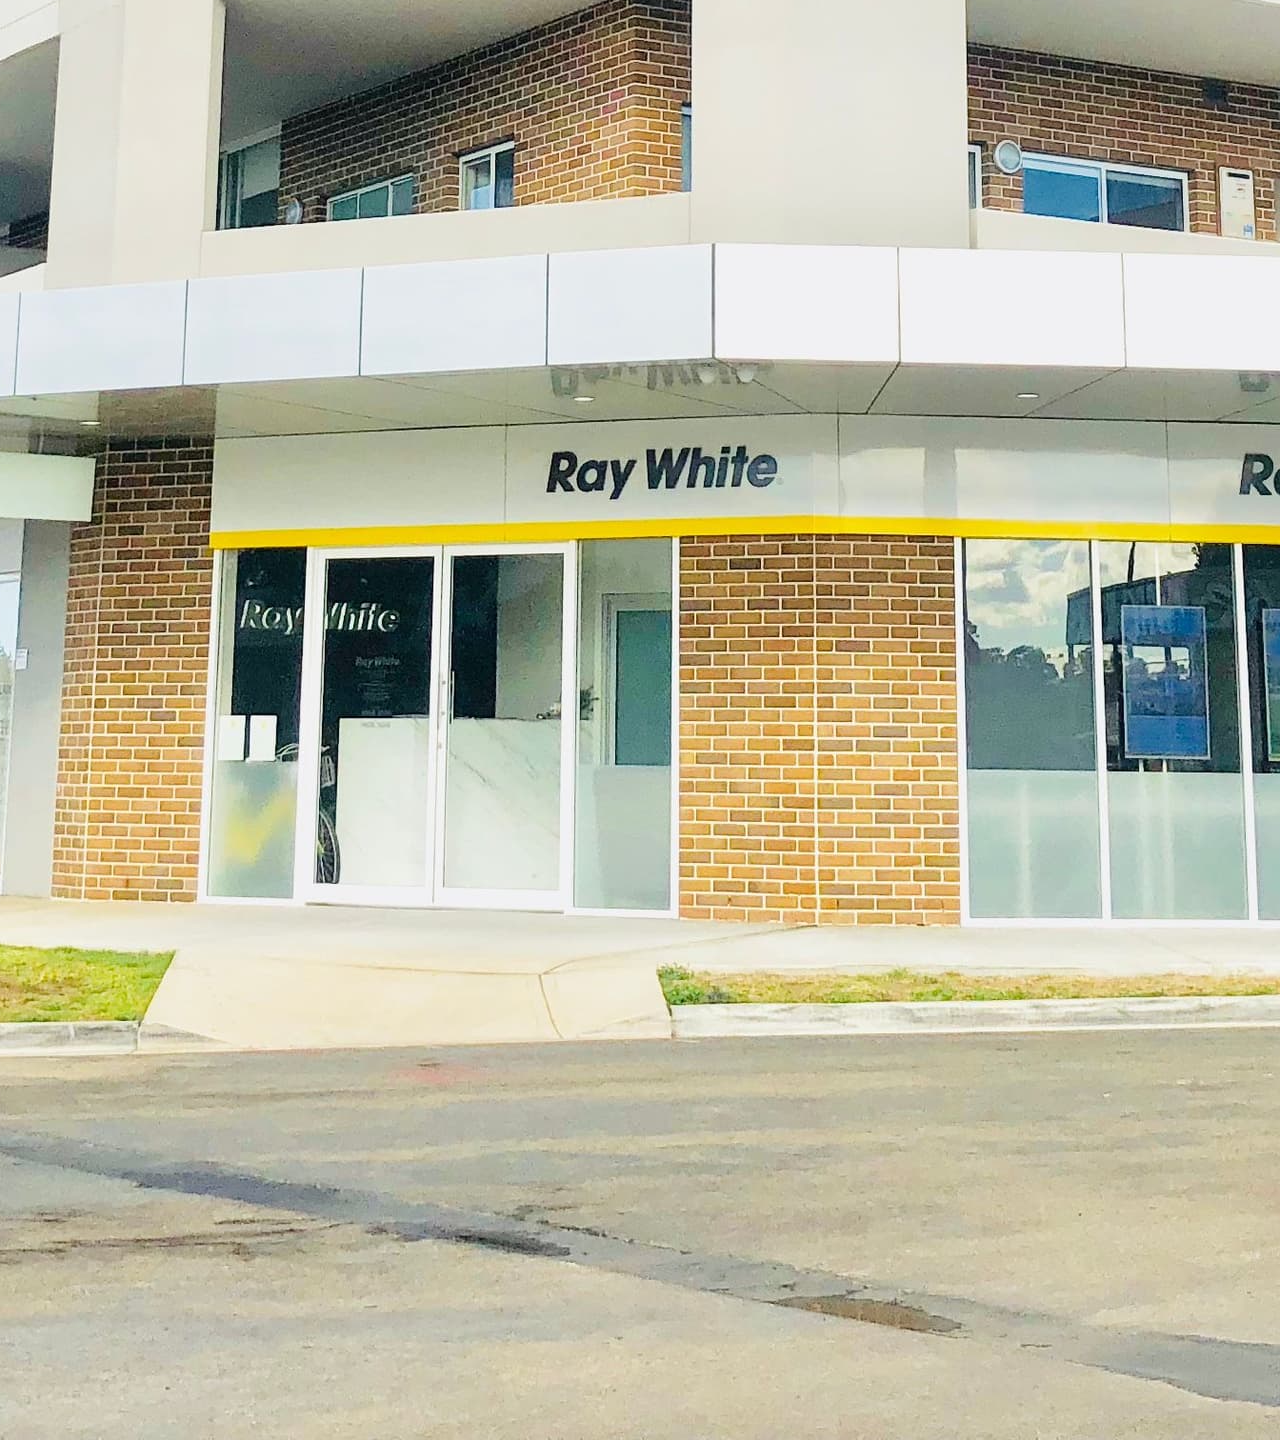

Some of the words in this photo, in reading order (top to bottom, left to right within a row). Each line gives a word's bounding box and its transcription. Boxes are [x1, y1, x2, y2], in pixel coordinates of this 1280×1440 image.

[544, 451, 637, 500] Ray
[646, 446, 778, 489] White
[240, 599, 304, 635] Ray
